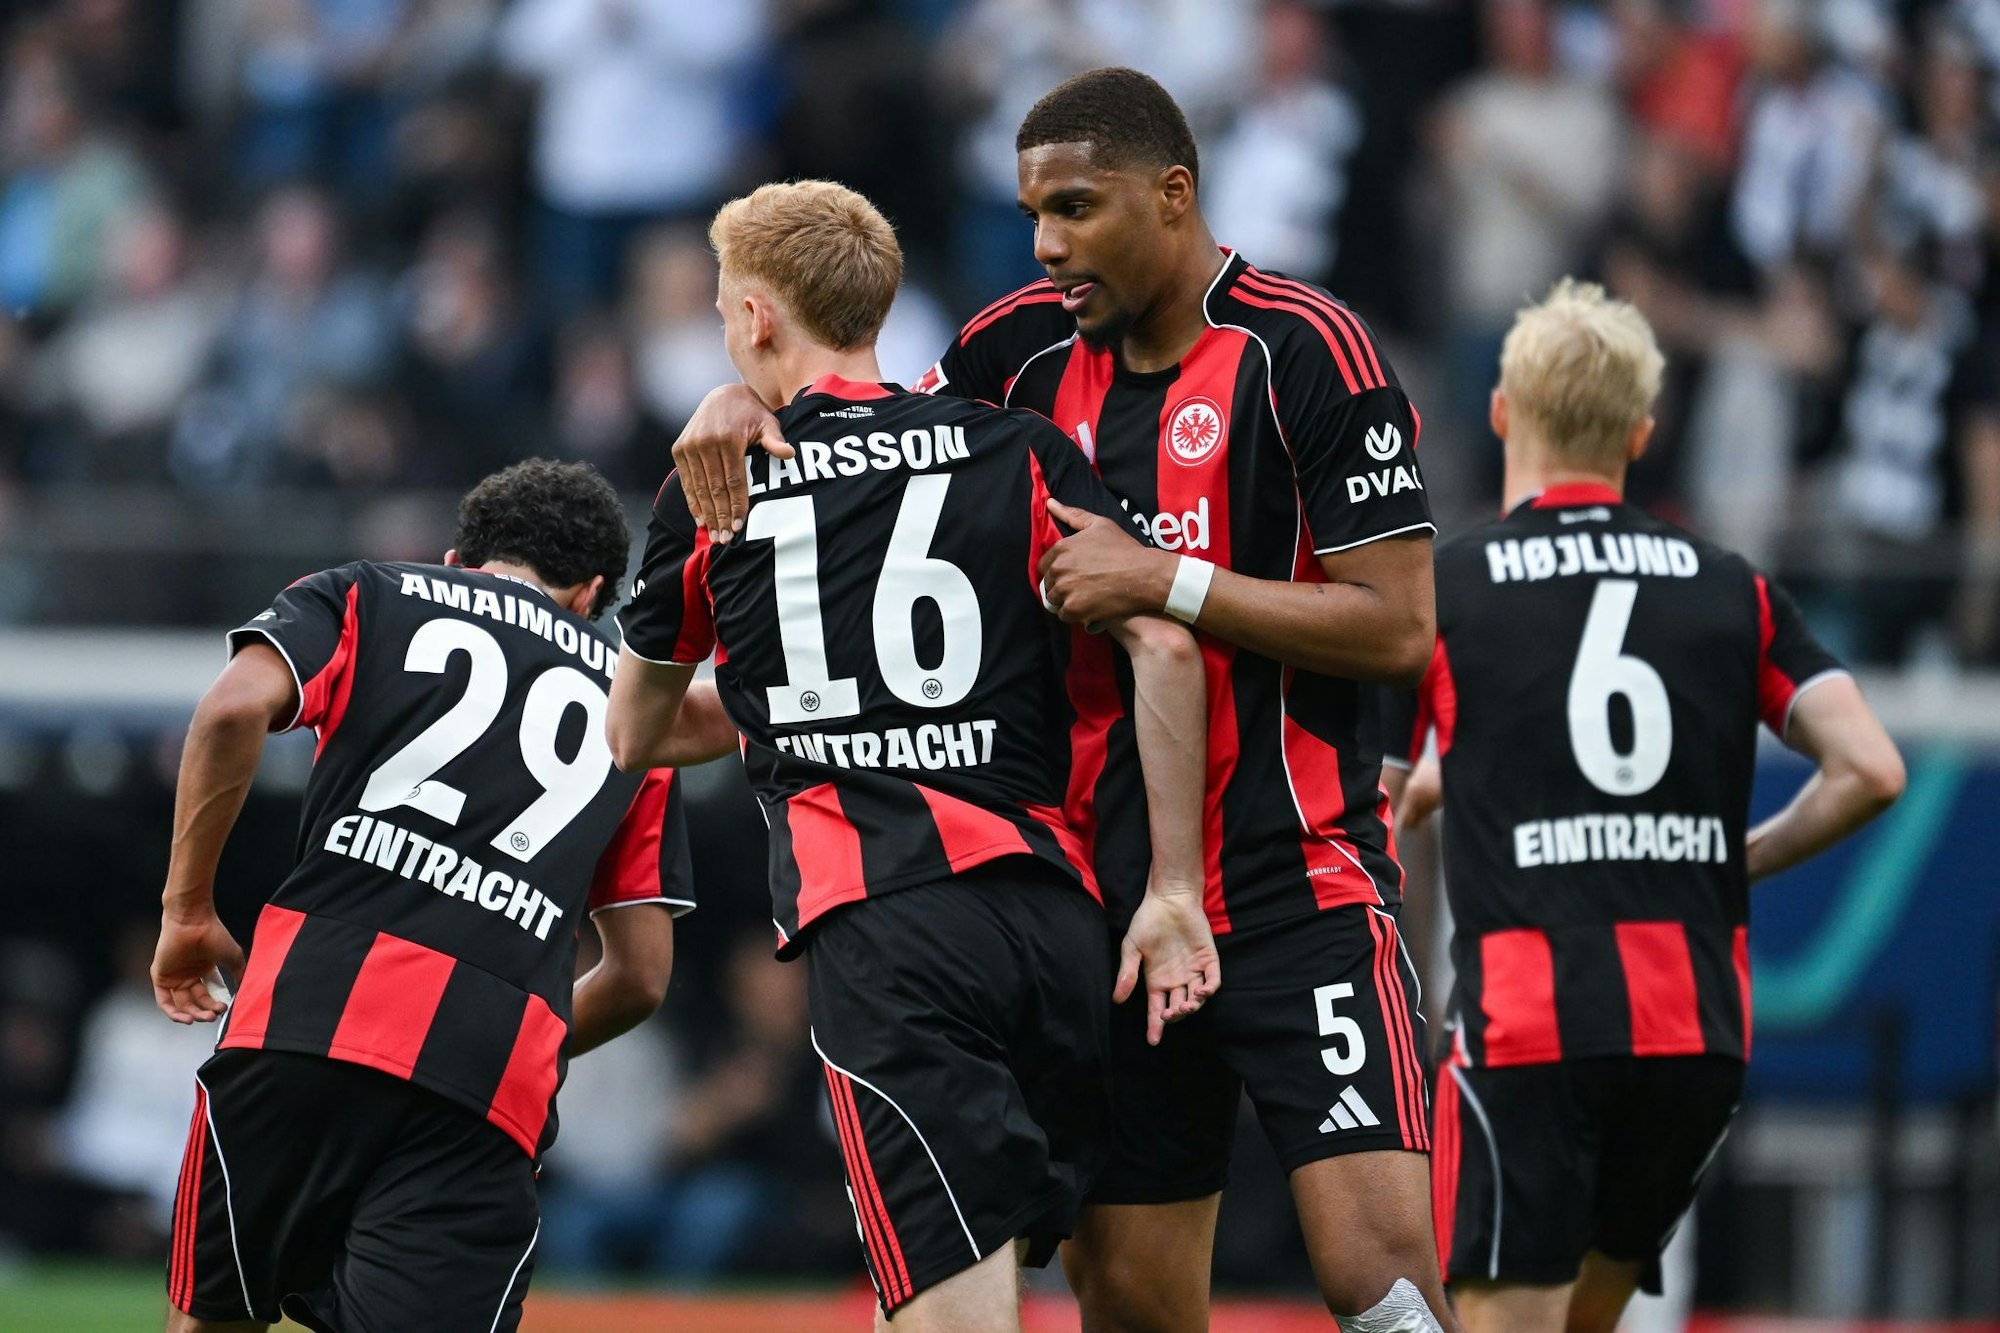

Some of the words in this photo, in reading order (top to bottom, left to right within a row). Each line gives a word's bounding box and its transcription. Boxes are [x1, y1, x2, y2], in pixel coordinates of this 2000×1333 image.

[744, 425, 970, 496] LARSSON
[745, 473, 983, 725] 16
[1485, 532, 1700, 583] HØJLUND
[357, 617, 614, 863] 29
[1567, 578, 1673, 796] 6
[323, 814, 563, 941] EINTRACHT
[1313, 982, 1366, 1076] 5
